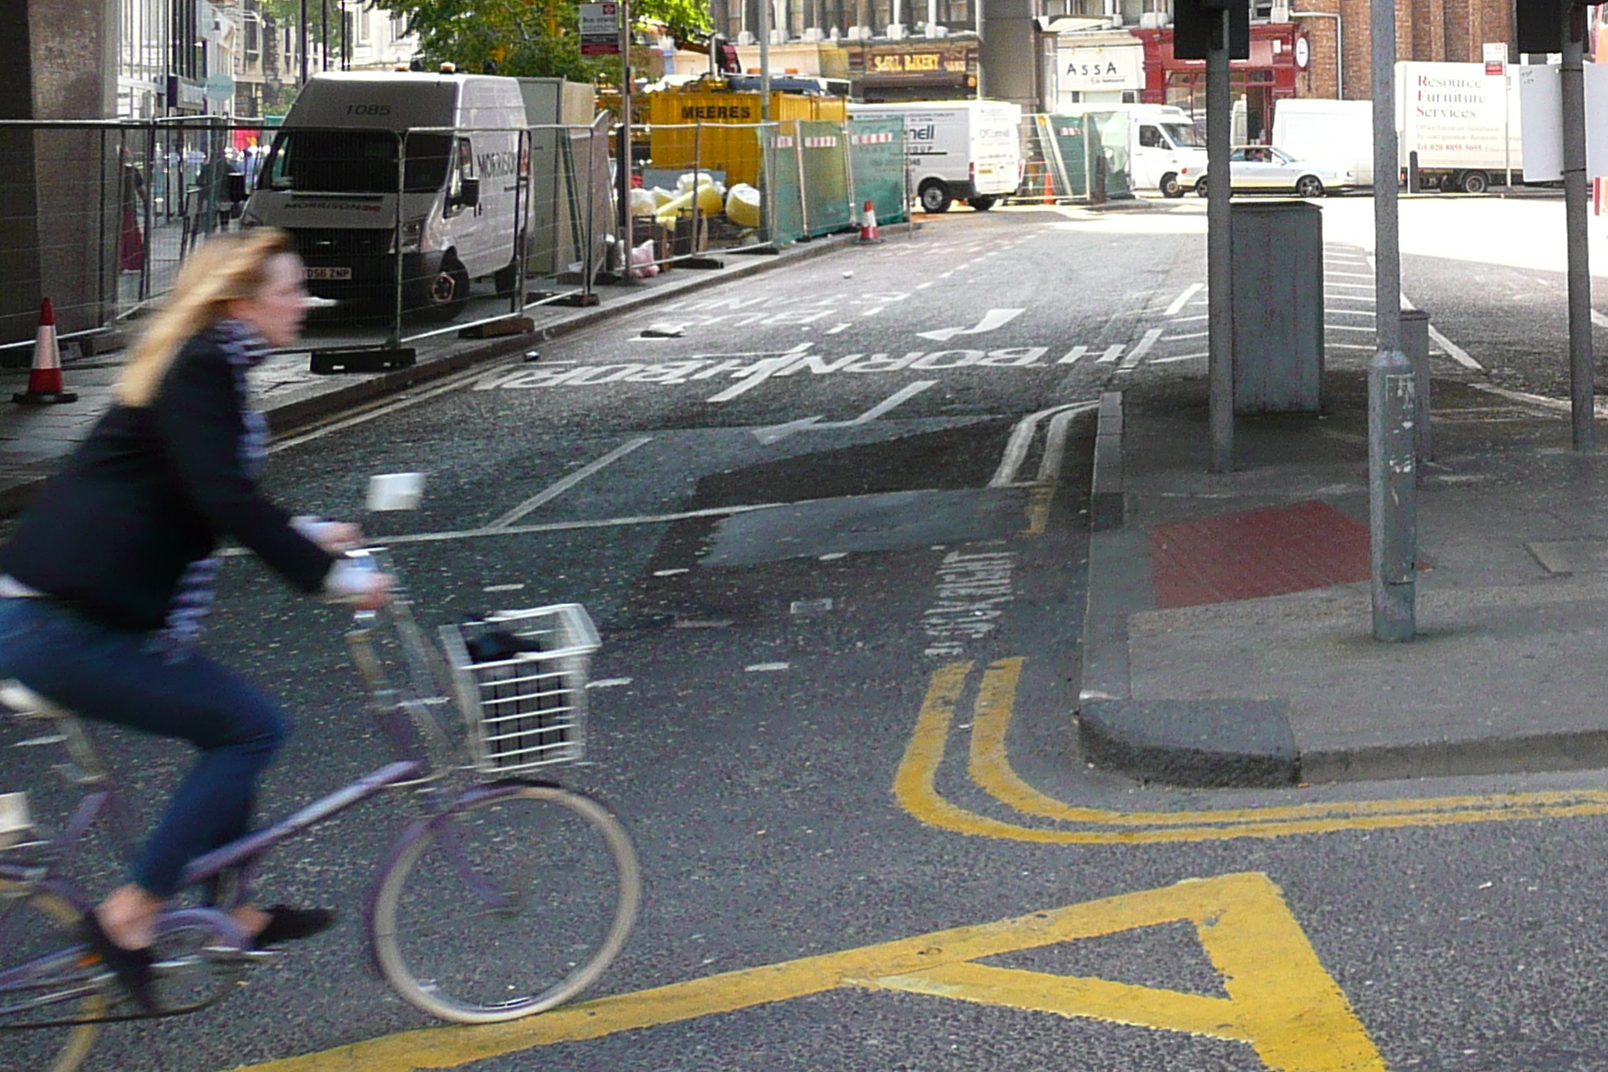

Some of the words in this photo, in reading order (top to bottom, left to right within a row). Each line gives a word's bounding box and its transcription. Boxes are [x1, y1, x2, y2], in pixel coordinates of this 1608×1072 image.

[1417, 75, 1483, 88] Resource
[1417, 90, 1487, 104] Furniture
[345, 103, 391, 116] 1085
[681, 105, 751, 120] MEERES
[1416, 105, 1476, 118] Services
[283, 201, 362, 211] MORRISON
